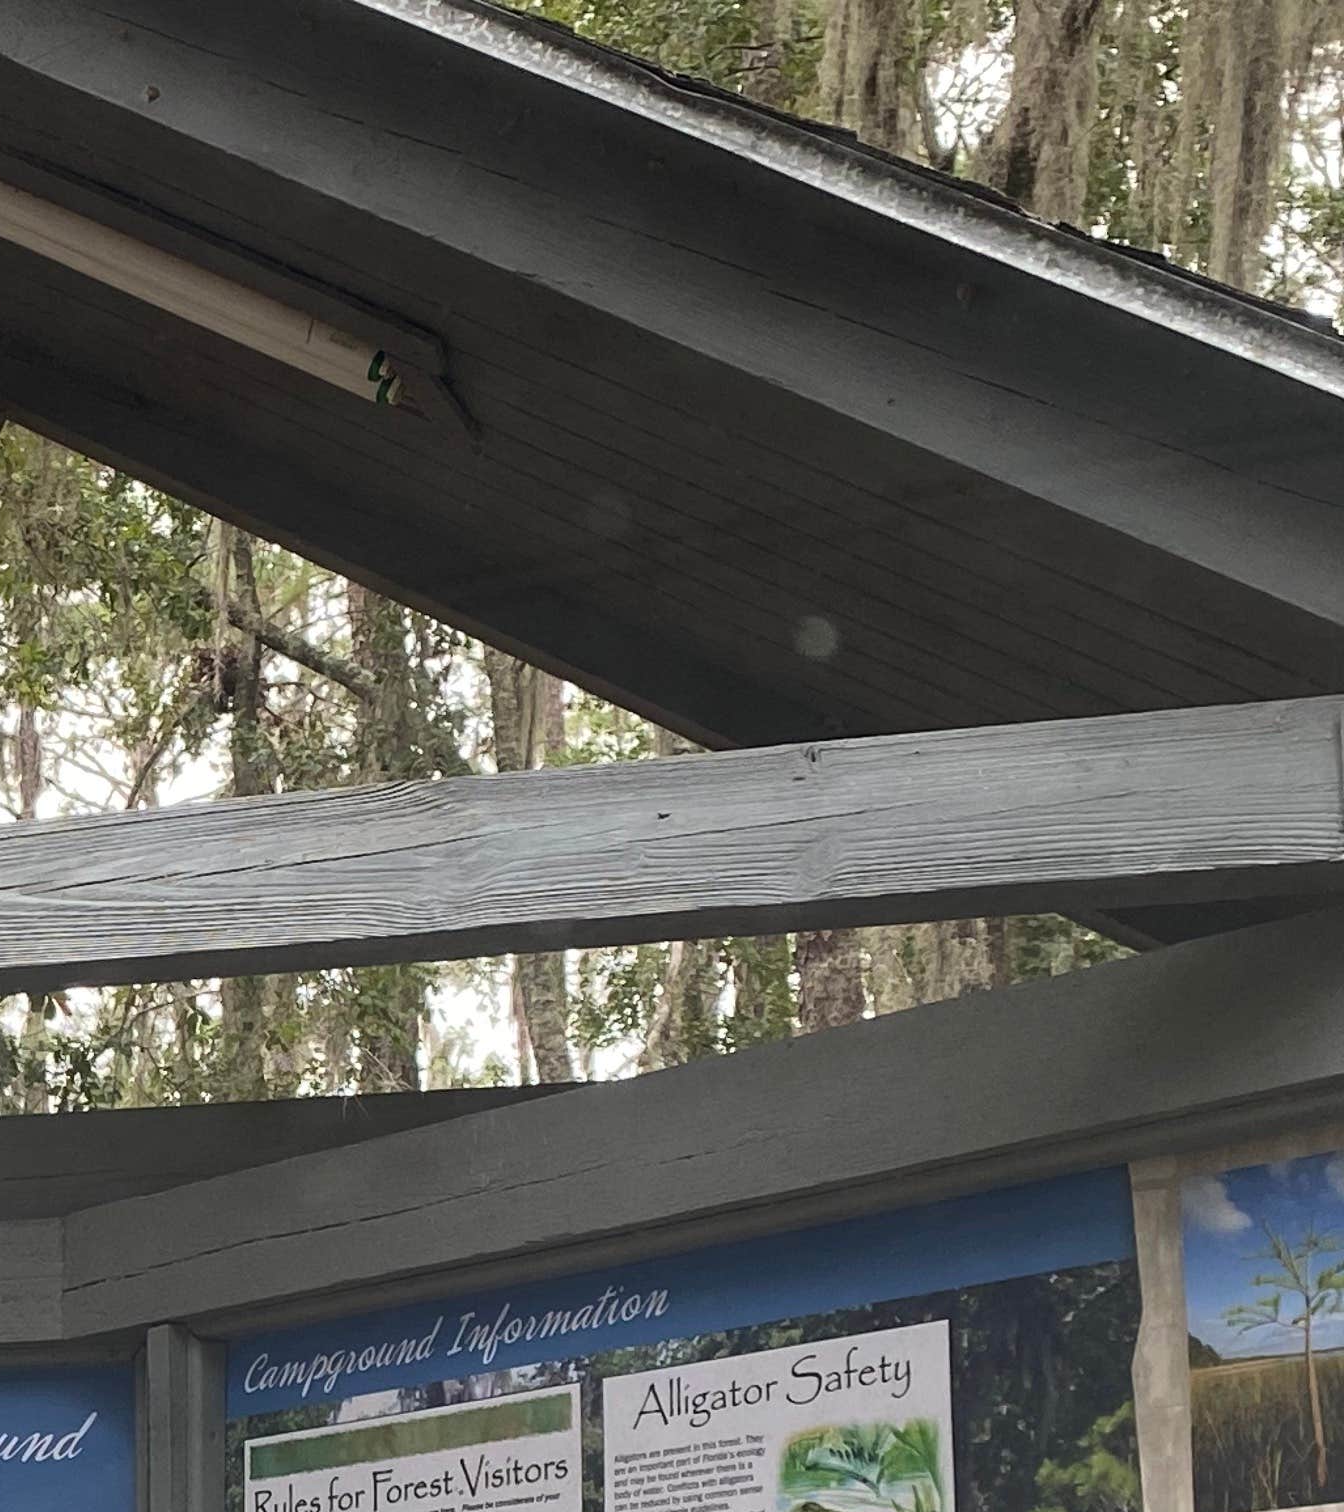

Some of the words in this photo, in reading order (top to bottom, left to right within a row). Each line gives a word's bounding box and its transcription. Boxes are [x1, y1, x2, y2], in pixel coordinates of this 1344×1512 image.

[244, 1316, 443, 1398] Campground
[447, 1285, 670, 1365] Information
[633, 1376, 777, 1430] Alligator
[786, 1347, 911, 1404] Safety
[328, 1476, 366, 1512] for
[373, 1468, 453, 1512] Forest
[460, 1455, 569, 1496] Visitors
